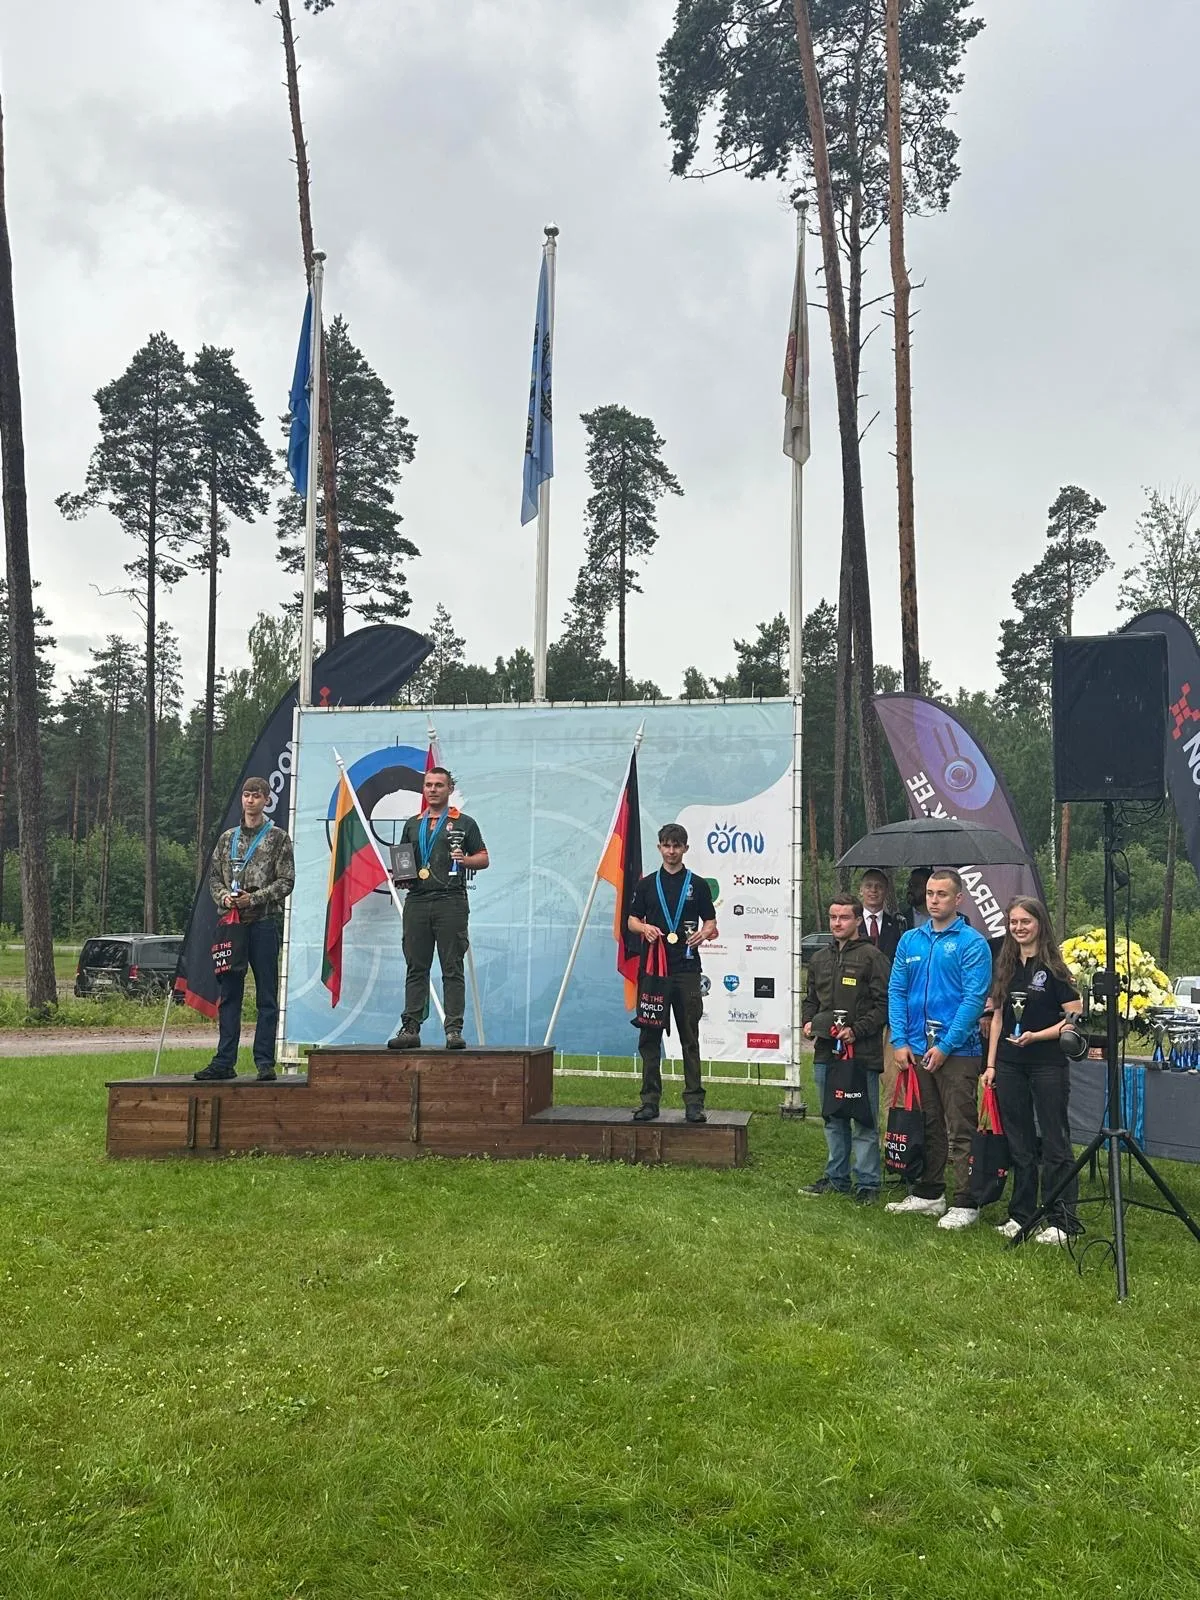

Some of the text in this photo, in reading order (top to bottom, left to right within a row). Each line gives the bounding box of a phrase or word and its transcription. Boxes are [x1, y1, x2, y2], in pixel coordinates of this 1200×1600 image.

[747, 875, 781, 886] Nocpix
[746, 906, 779, 915] SONMAK
[744, 933, 780, 942] ThermShop
[220, 942, 232, 950] THE
[650, 995, 664, 1003] THE
[640, 1001, 664, 1012] WORLD
[651, 1012, 657, 1020] A
[893, 1133, 908, 1142] THE
[895, 1152, 901, 1161] A
